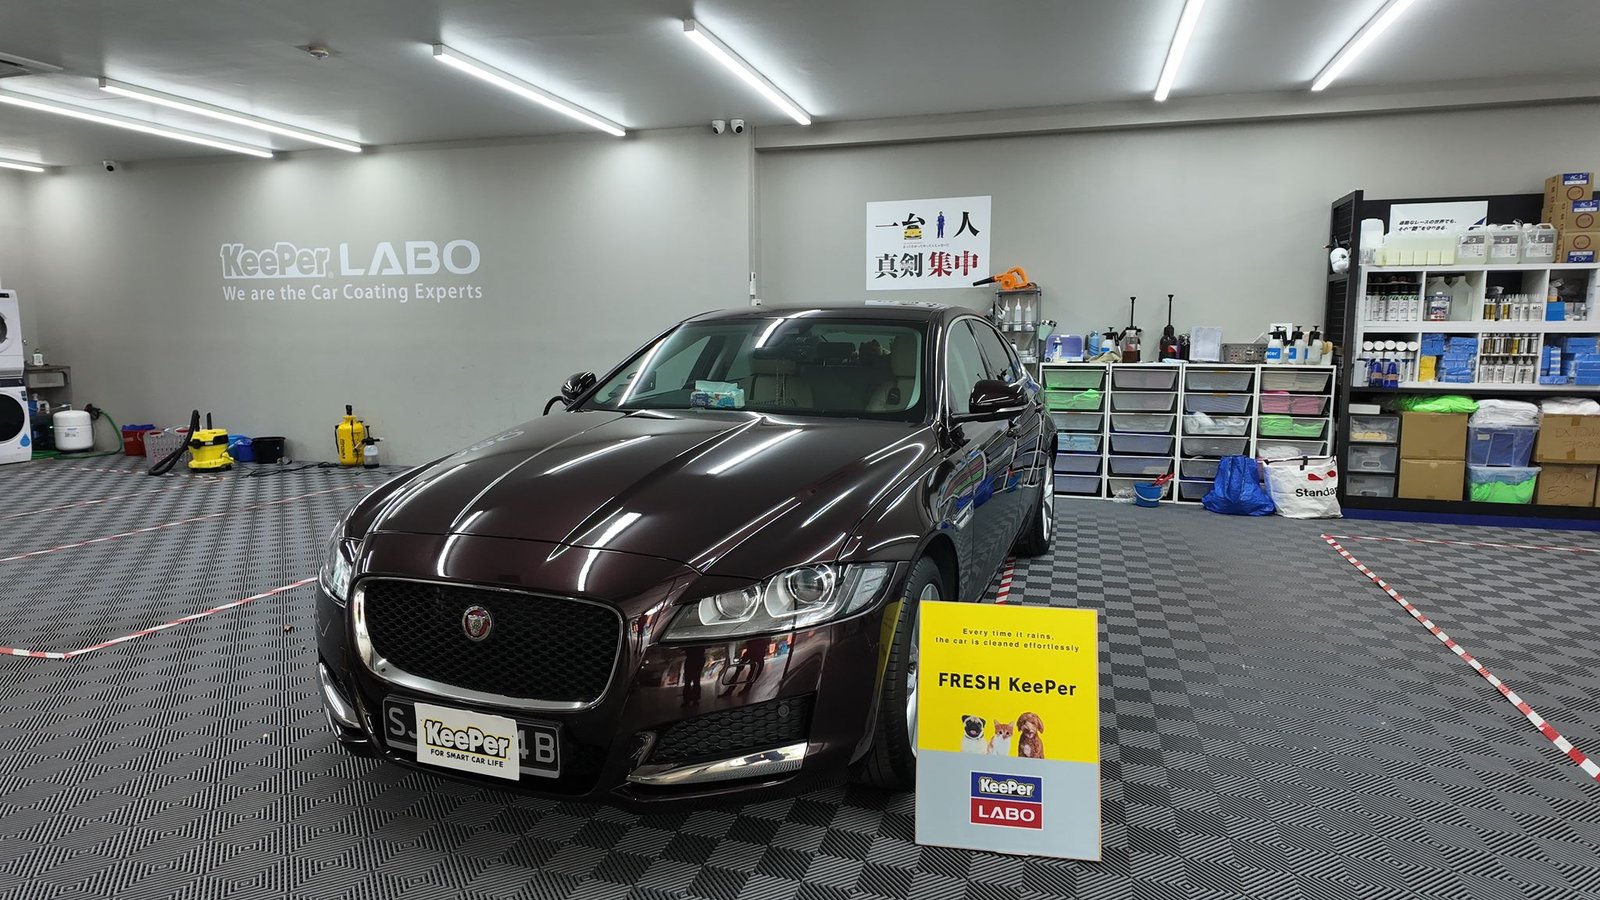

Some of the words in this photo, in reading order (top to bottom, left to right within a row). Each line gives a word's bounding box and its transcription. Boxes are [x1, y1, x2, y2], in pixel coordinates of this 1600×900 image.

[220, 242, 330, 278] KeePer
[339, 240, 480, 276] LABO
[874, 250, 979, 279] 真剣集中
[222, 286, 246, 300] We
[251, 288, 275, 300] are
[280, 284, 306, 300] the
[312, 284, 338, 300] Car
[343, 284, 408, 303] Coating
[415, 283, 482, 303] Experts
[962, 628, 989, 637] Every
[984, 639, 1020, 648] cleaned
[1024, 641, 1080, 652] effortlessly
[938, 672, 1000, 690] FRESH
[1009, 677, 1076, 696] KeePer
[424, 718, 510, 758] KeePer
[430, 748, 444, 757] FOR
[446, 752, 470, 762] SMART
[471, 756, 486, 765] CAR
[488, 758, 504, 768] LIFE
[978, 776, 1035, 798] KeePer
[978, 804, 1035, 822] LABO
